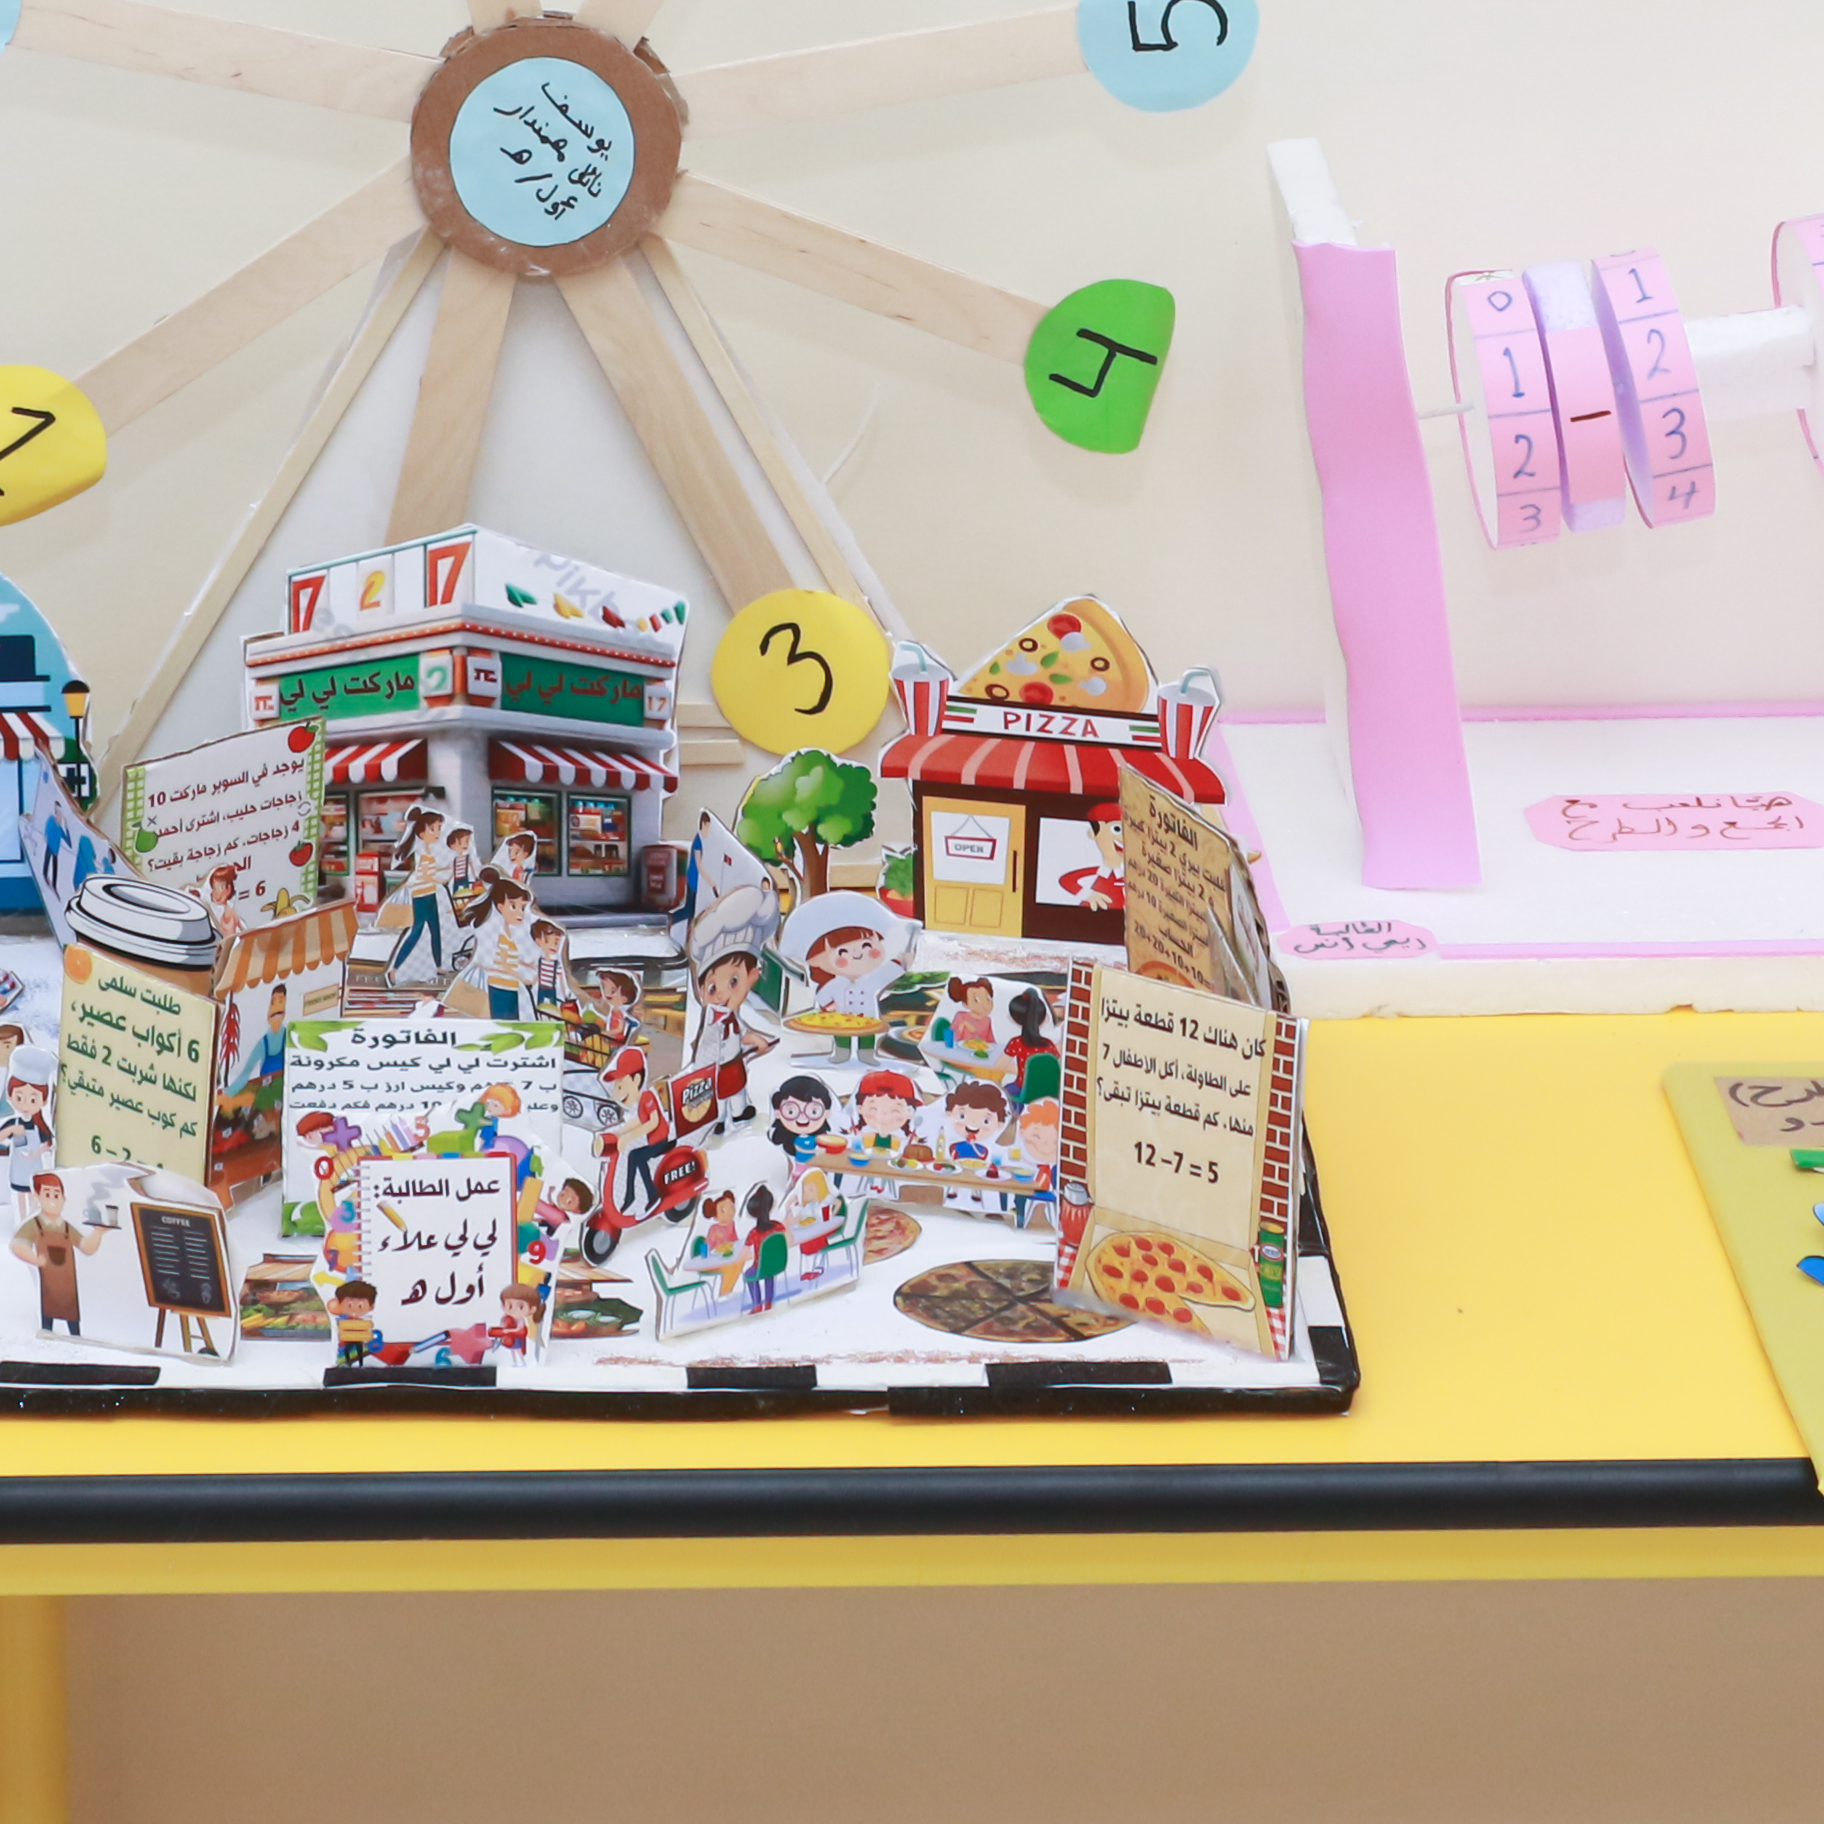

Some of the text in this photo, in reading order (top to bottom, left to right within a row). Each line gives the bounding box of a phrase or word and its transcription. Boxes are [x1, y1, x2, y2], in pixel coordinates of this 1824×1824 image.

[1047, 325, 1161, 400] 4
[1503, 346, 1525, 399] 1
[1663, 408, 1688, 461] 3
[1513, 434, 1536, 480] 2
[759, 621, 835, 715] 3
[280, 670, 416, 712] ماركت لي لي
[1003, 711, 1099, 738] PIZZA
[148, 791, 167, 808] 10
[954, 843, 984, 853] OPEN
[98, 976, 182, 1016] طلبت سلمى
[132, 1024, 182, 1058] أكواب
[351, 1028, 456, 1049] الفاتورة
[1101, 998, 1267, 1060] كان هناك 12 قطعة بيتزا
[188, 1040, 200, 1063] 6
[290, 1055, 556, 1075] اشترت لي لي كيس مكرونة
[682, 1078, 712, 1105] Pizza
[147, 1109, 176, 1130] كوب
[664, 1160, 696, 1185] FREE!
[1134, 1141, 1219, 1183] 12 5
[455, 1177, 501, 1201] عمل
[378, 1218, 498, 1258] لي لي علاء
[435, 1263, 485, 1305] أول
